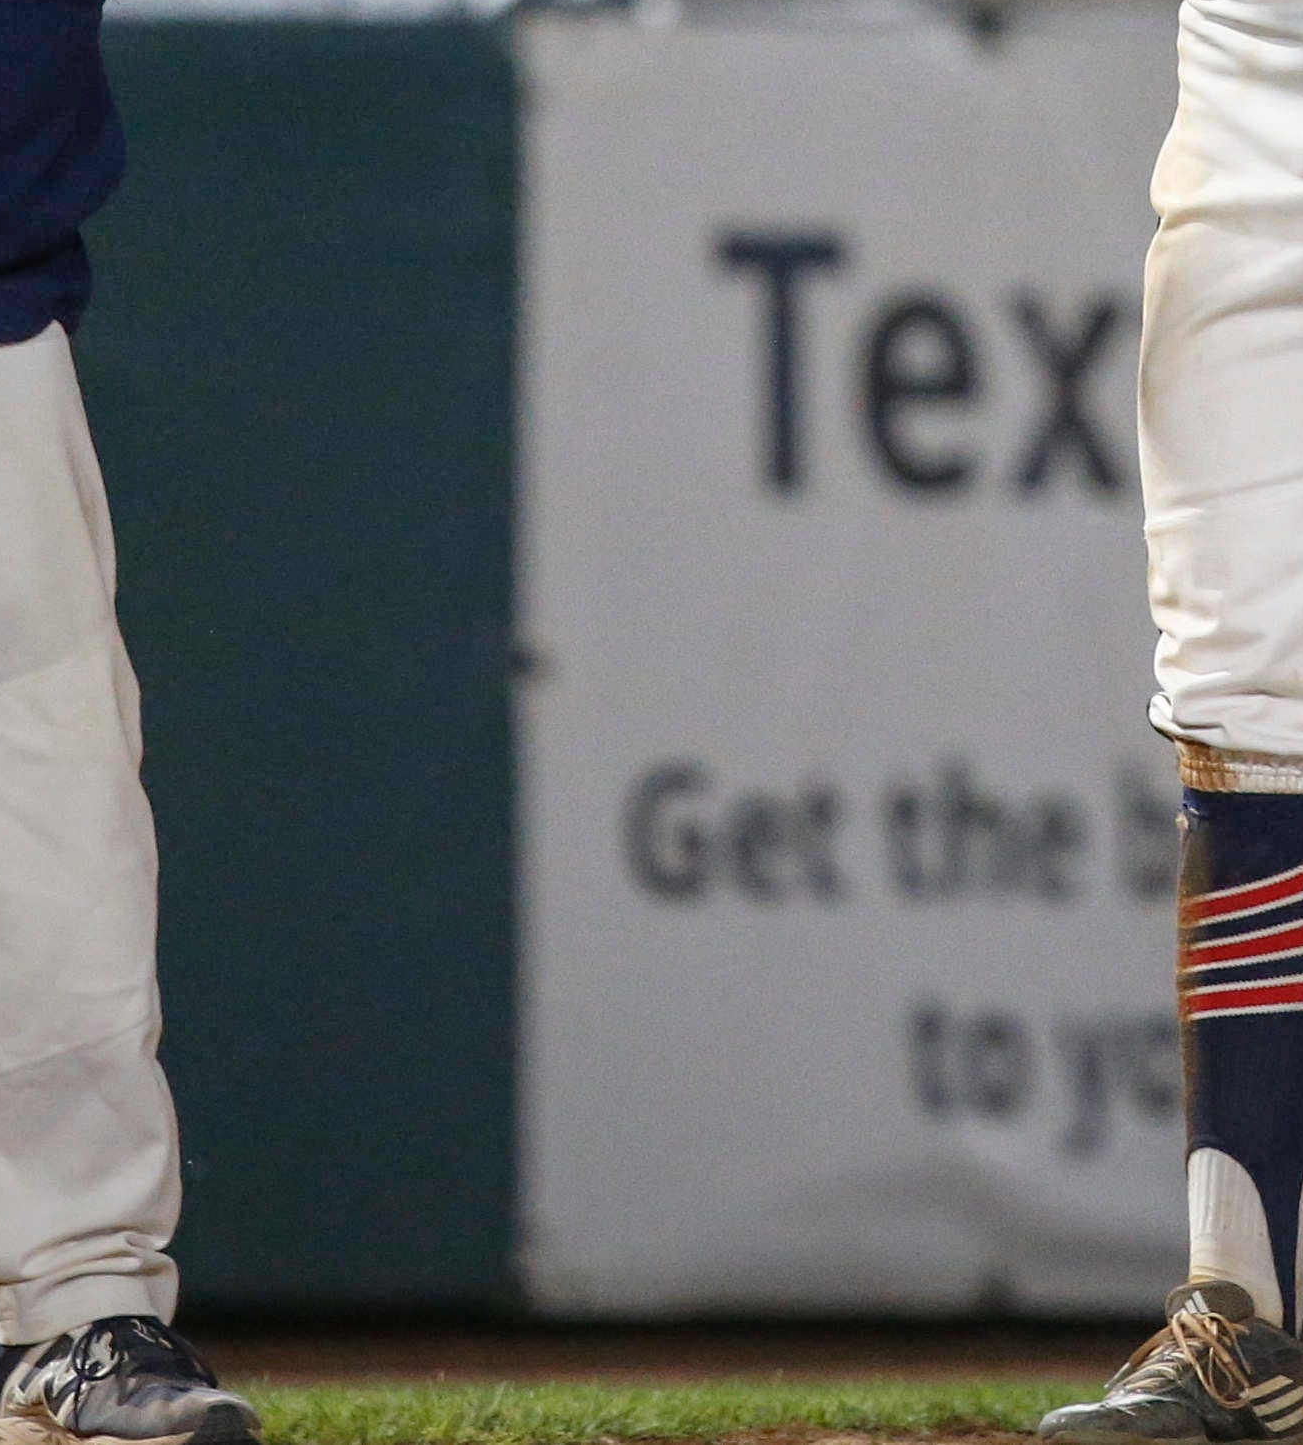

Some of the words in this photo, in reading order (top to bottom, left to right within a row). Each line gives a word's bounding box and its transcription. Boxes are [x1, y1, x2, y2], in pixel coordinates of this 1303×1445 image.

[715, 228, 1142, 500] Tex
[627, 758, 847, 903] Get
[885, 755, 1087, 903] the
[907, 991, 1032, 1117] to
